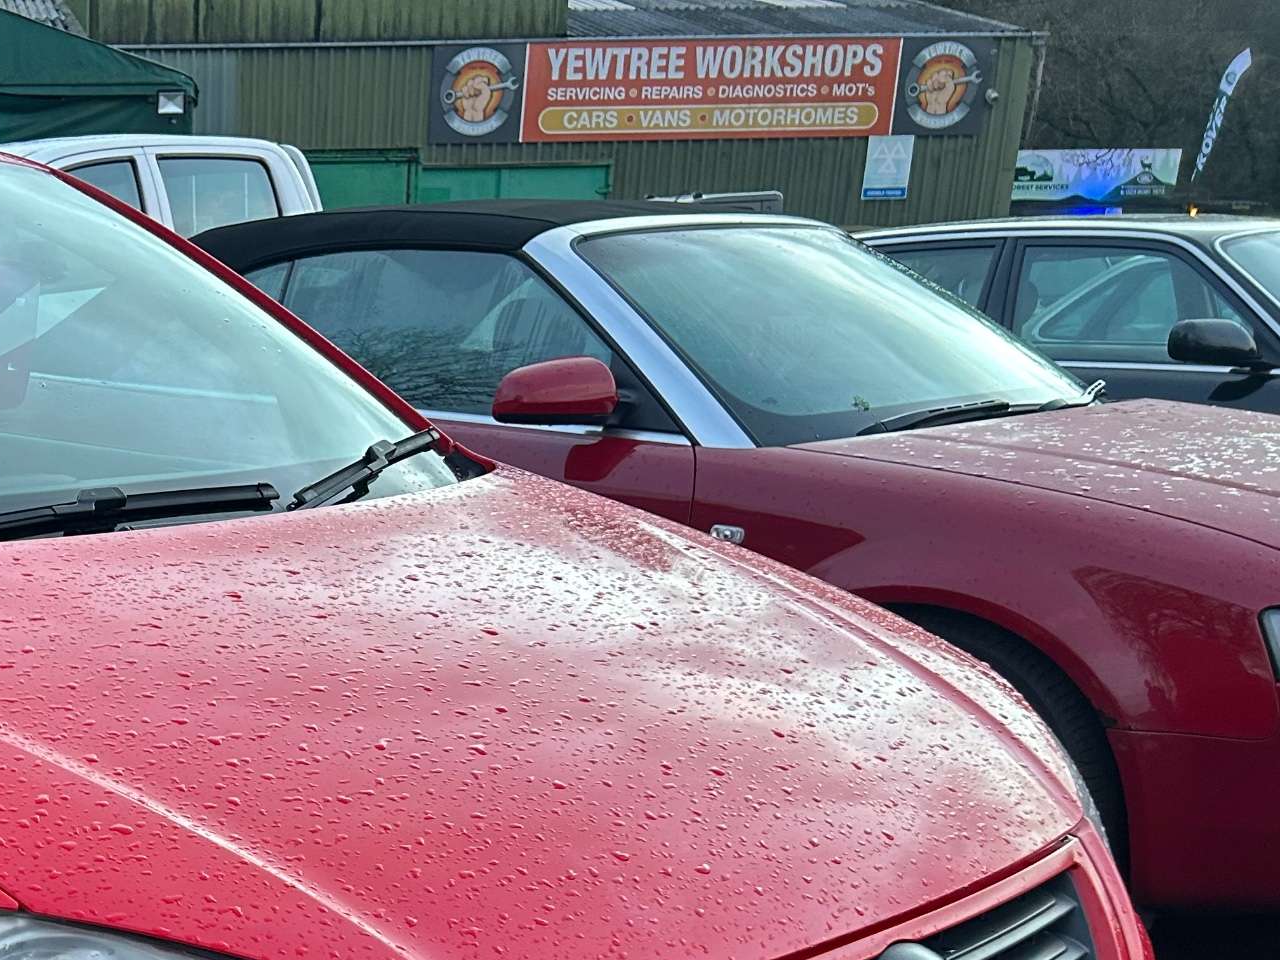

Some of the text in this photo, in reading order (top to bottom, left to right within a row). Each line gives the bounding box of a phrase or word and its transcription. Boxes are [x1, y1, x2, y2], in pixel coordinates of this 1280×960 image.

[547, 43, 883, 81] YEWTREE WORKSHOPS
[547, 82, 875, 101] SERVICING REPAIRS DIAGNOSTICS MOT's
[563, 107, 859, 129] CARS VANS MOTORHOMES
